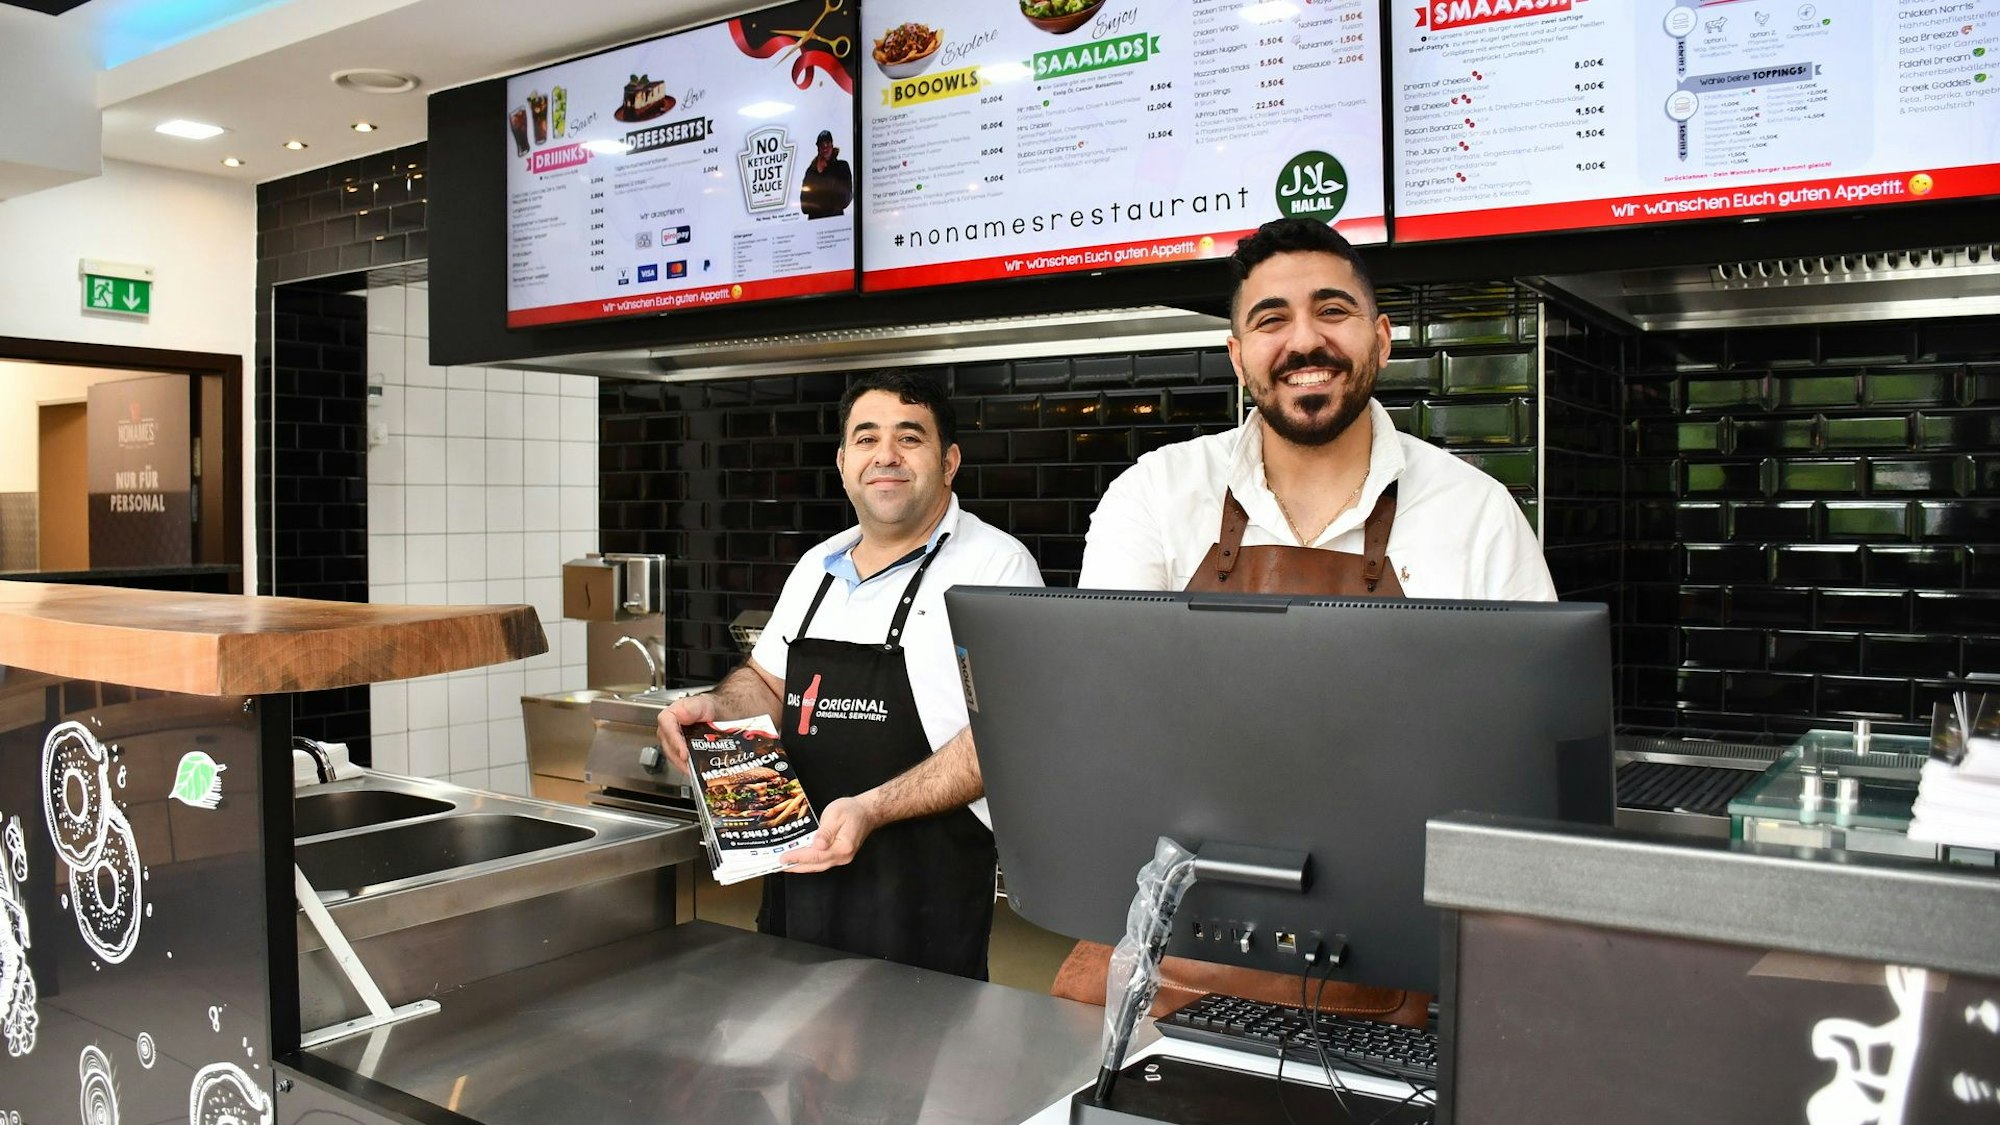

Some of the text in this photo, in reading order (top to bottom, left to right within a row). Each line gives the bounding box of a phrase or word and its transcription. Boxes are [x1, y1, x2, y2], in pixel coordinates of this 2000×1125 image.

[1193, 7, 1217, 17] Chicken
[1899, 8, 1937, 19] Chicken
[1940, 2, 1974, 13] Norris
[1092, 7, 1138, 40] Enjoy
[1298, 19, 1333, 29] NoNames
[1340, 12, 1362, 22] 1,50€
[1558, 13, 1583, 24] saftige
[1193, 24, 1239, 37] Chicken Wings
[1899, 30, 1959, 44] Sea Breeze
[941, 28, 999, 66] Explore
[1259, 36, 1284, 46] 5,50€
[1299, 34, 1363, 50] NoNames 1,50€
[1899, 36, 1999, 55] Black Tiger Garnelen
[1036, 38, 1145, 75] SAAALADS
[1193, 44, 1248, 57] Chicken Nuggets
[1260, 57, 1284, 67] 5,50€
[1338, 54, 1364, 64] 2,00€
[1575, 58, 1604, 70] 8,00€
[1899, 54, 1971, 69] Falafel Dream
[1727, 74, 1750, 83] Deine
[1753, 67, 1806, 80] TOPPINGS:
[894, 71, 978, 102] BOOOWLS
[1150, 82, 1172, 91] 8,50€
[1260, 78, 1285, 88] 5,50€
[1403, 81, 1430, 91] Dream
[1575, 81, 1604, 92] 9,00€
[1899, 78, 1972, 93] Greek Goddes
[1213, 88, 1231, 96] Rings
[680, 88, 705, 111] Love
[981, 95, 1003, 104] 10,00€
[1256, 99, 1284, 110] 22,50€
[1147, 102, 1172, 112] 12,00€
[1310, 103, 1336, 111] Chicken
[1576, 106, 1605, 116] 9,50€
[1908, 100, 1975, 114] Pestoaufstrich
[981, 121, 1003, 131] 10,00€
[1404, 125, 1429, 135] Bacon
[630, 120, 704, 150] DEEESSERTS
[1148, 130, 1173, 139] 13,50€
[1576, 129, 1605, 139] 9,50€
[757, 138, 778, 154] NO
[981, 147, 1003, 156] 10,00€
[1405, 149, 1420, 157] The
[748, 153, 788, 168] KETCHUP
[1576, 161, 1605, 171] 9,00€
[753, 166, 782, 183] JUST
[1281, 161, 1344, 196] حلال
[1431, 176, 1455, 185] Fiesta
[752, 181, 782, 194] SAUCE
[1291, 197, 1334, 213] HALAL
[1611, 179, 1905, 218] Wir wünschen Euch guten Appetit.
[894, 187, 1249, 248] #nonamesrestaurant
[1004, 240, 1196, 271] Wir wünschen Euch guten Appetit.
[641, 270, 655, 278] VISA
[603, 303, 615, 312] Wir
[617, 298, 655, 311] wünschen
[655, 296, 674, 306] Euch
[676, 294, 698, 305] guten
[118, 424, 154, 442] NONAMES
[116, 464, 158, 489] NUR FÜR
[110, 494, 165, 512] PERSONAL
[787, 693, 800, 707] DAS
[819, 699, 888, 713] ORIGINAL
[816, 711, 887, 722] ORIGINAL SERVIERT
[691, 741, 736, 749] NONAMES
[701, 752, 779, 781] MECHERNICH
[710, 752, 754, 768] Hallo
[741, 830, 769, 839] 2443
